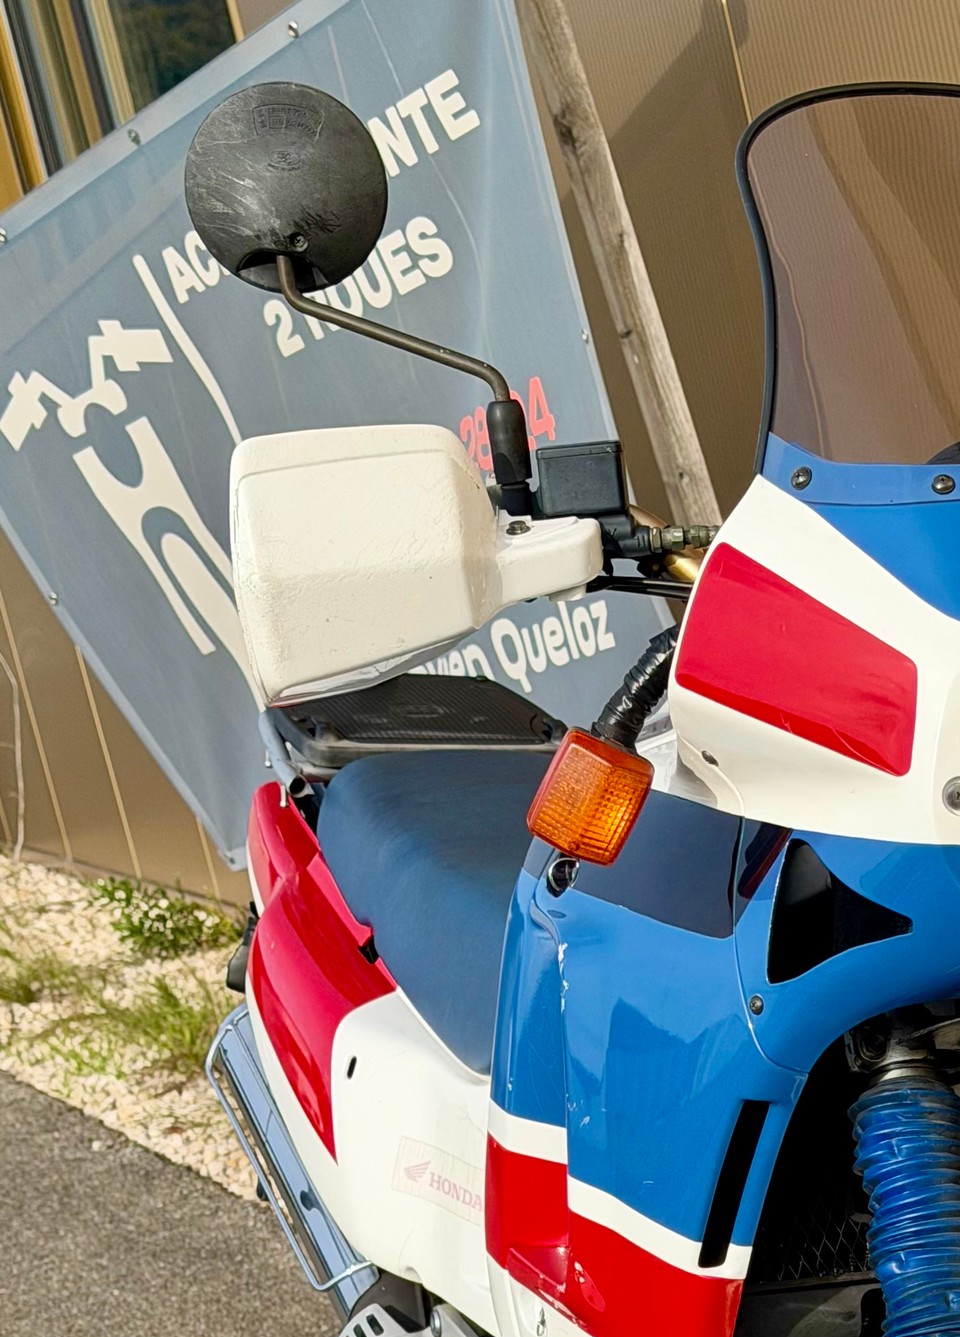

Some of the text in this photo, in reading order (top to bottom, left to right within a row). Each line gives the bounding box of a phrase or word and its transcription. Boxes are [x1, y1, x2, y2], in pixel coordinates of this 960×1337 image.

[161, 68, 481, 305] AC NTE
[262, 298, 306, 358] 2
[490, 600, 616, 694] Queloz
[428, 1171, 483, 1212] HONDA
